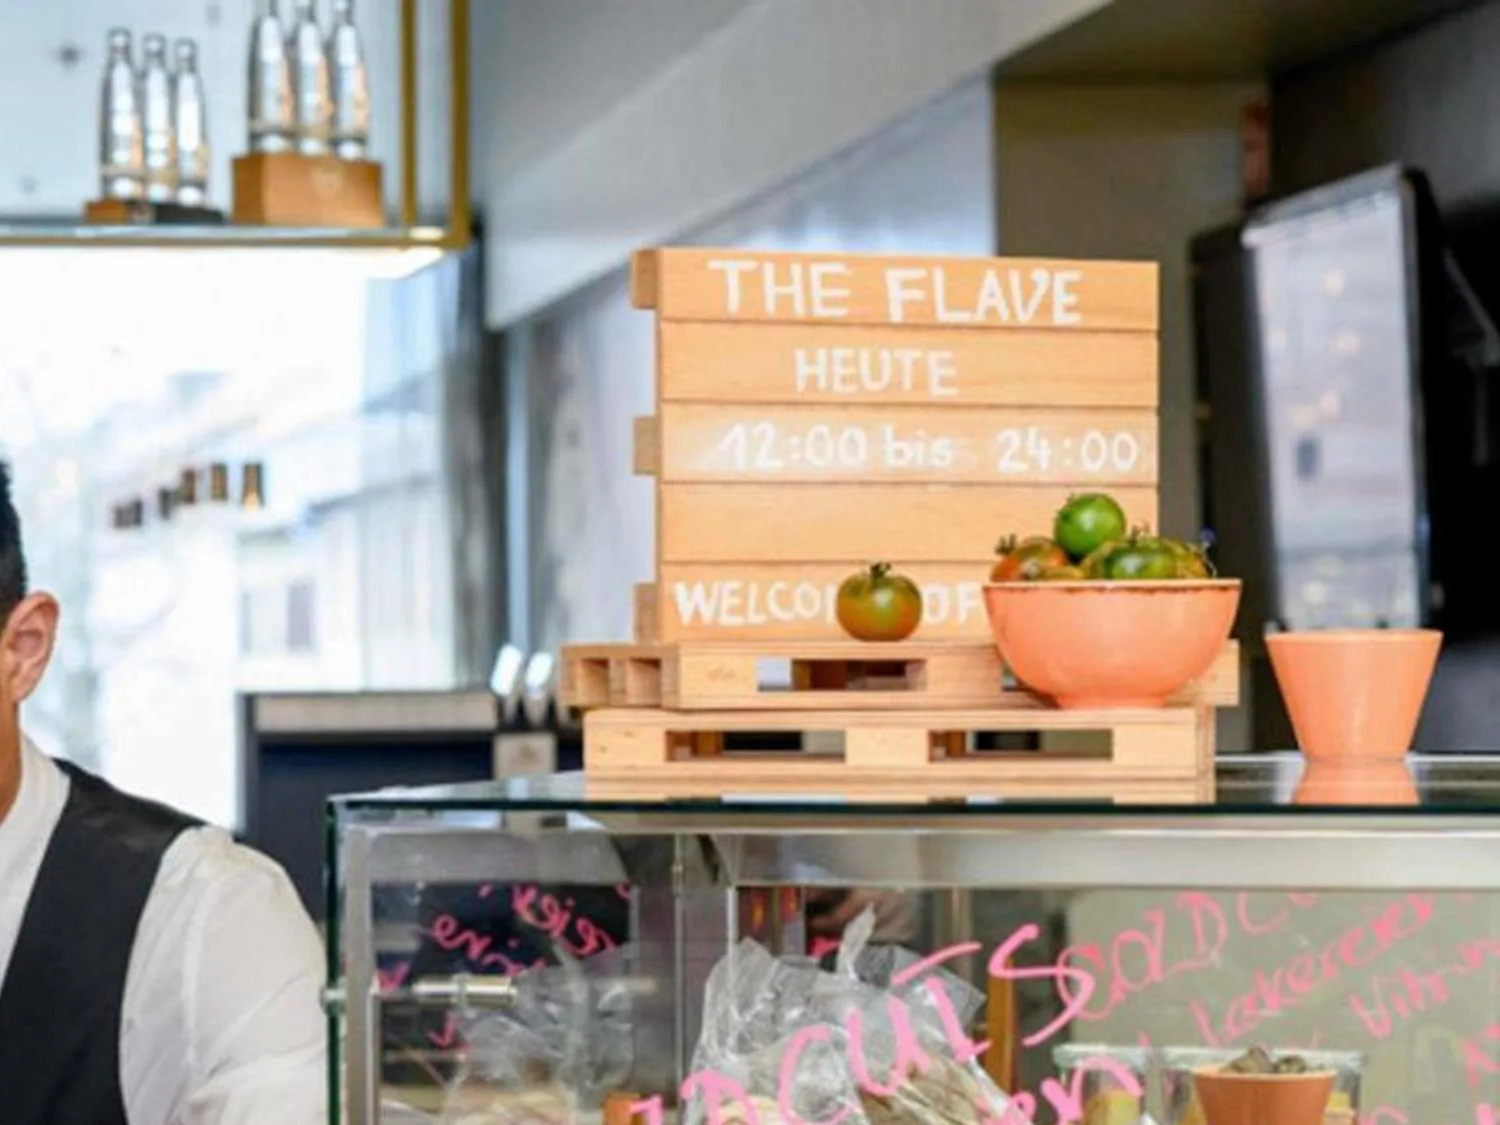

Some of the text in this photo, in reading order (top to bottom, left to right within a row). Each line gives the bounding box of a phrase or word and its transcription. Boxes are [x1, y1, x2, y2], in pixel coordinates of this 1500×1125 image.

[707, 259, 1083, 325] THE FLAVE
[794, 347, 959, 397] HEUTE
[715, 422, 1139, 474] 12:00 bis 24:00
[674, 578, 837, 627] WELCO
